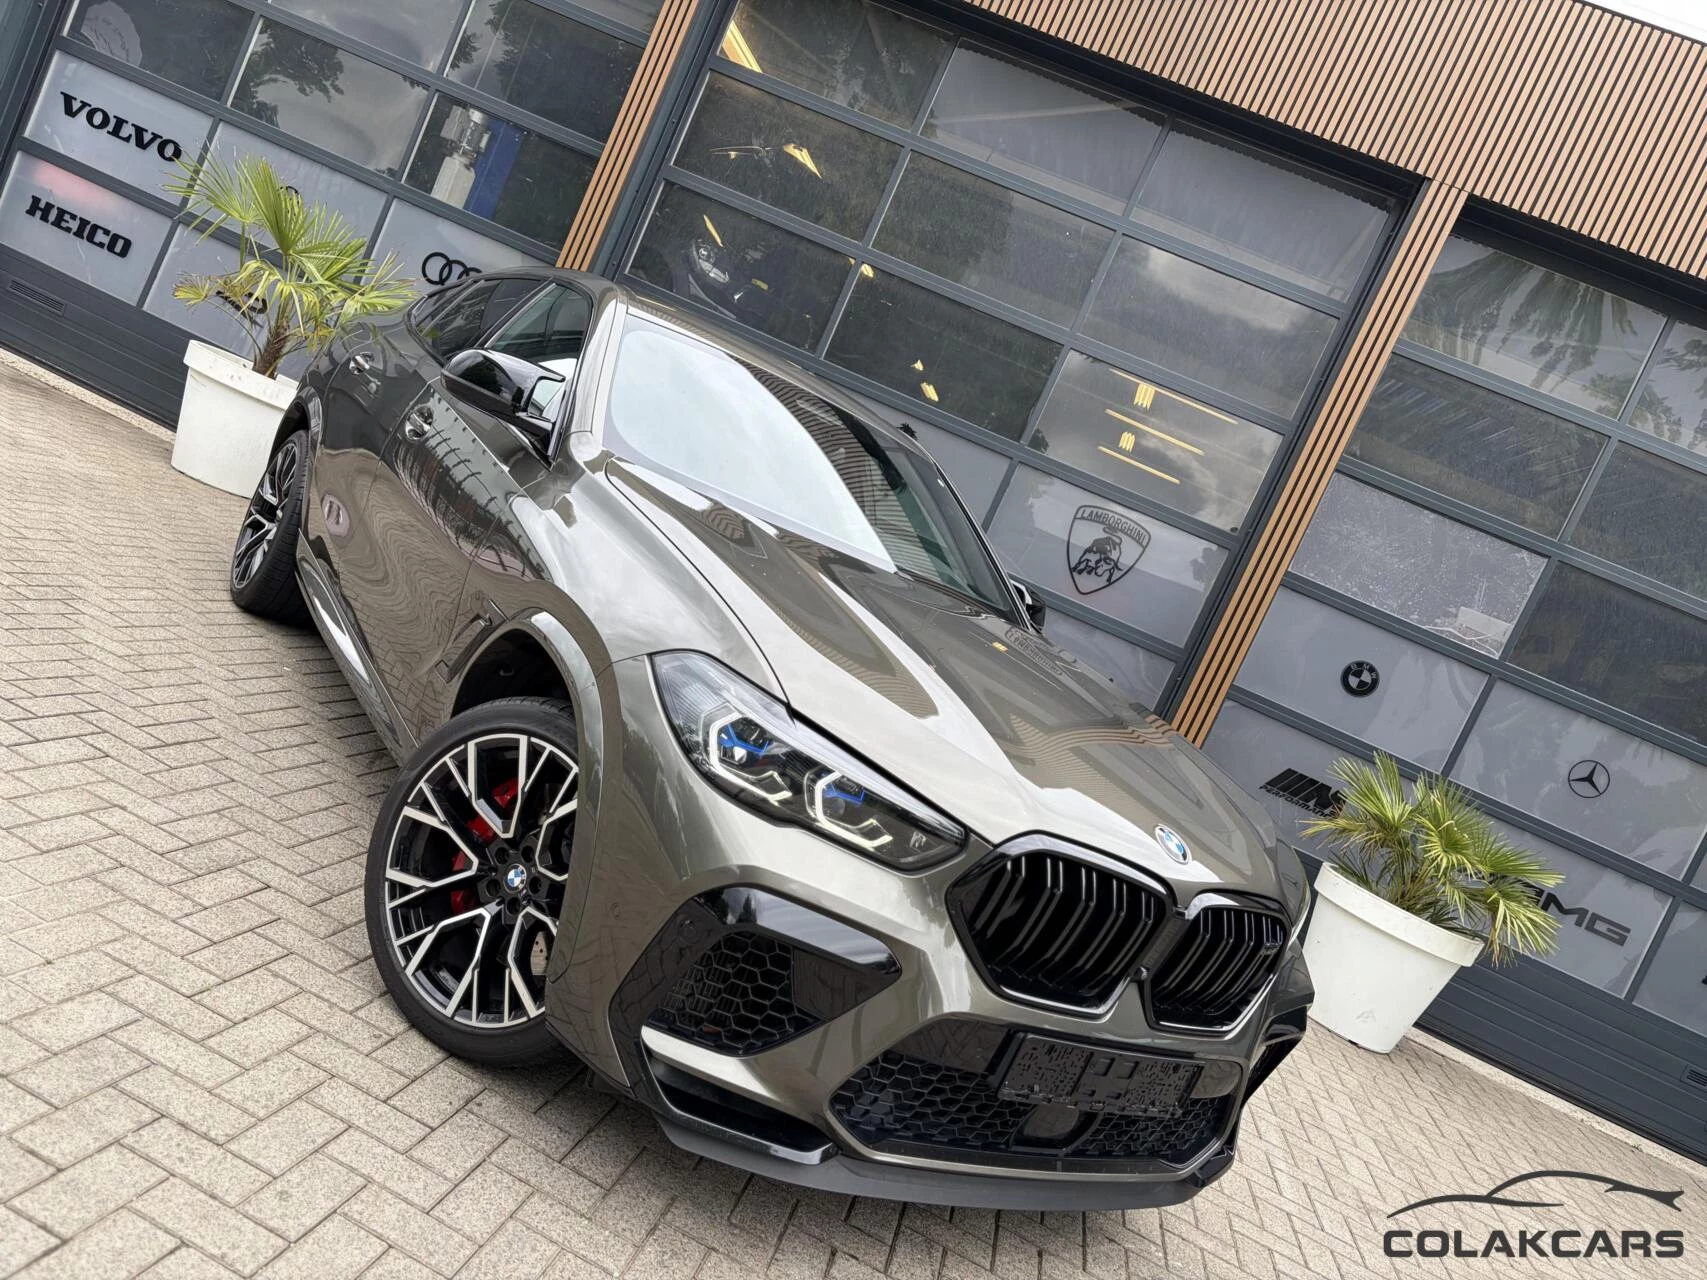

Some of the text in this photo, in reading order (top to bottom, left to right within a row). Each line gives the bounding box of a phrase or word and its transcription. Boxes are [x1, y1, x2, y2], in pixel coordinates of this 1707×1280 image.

[60, 91, 182, 162] VOLVO
[25, 195, 132, 259] HEICO
[1080, 508, 1147, 544] LAMBORGHINI
